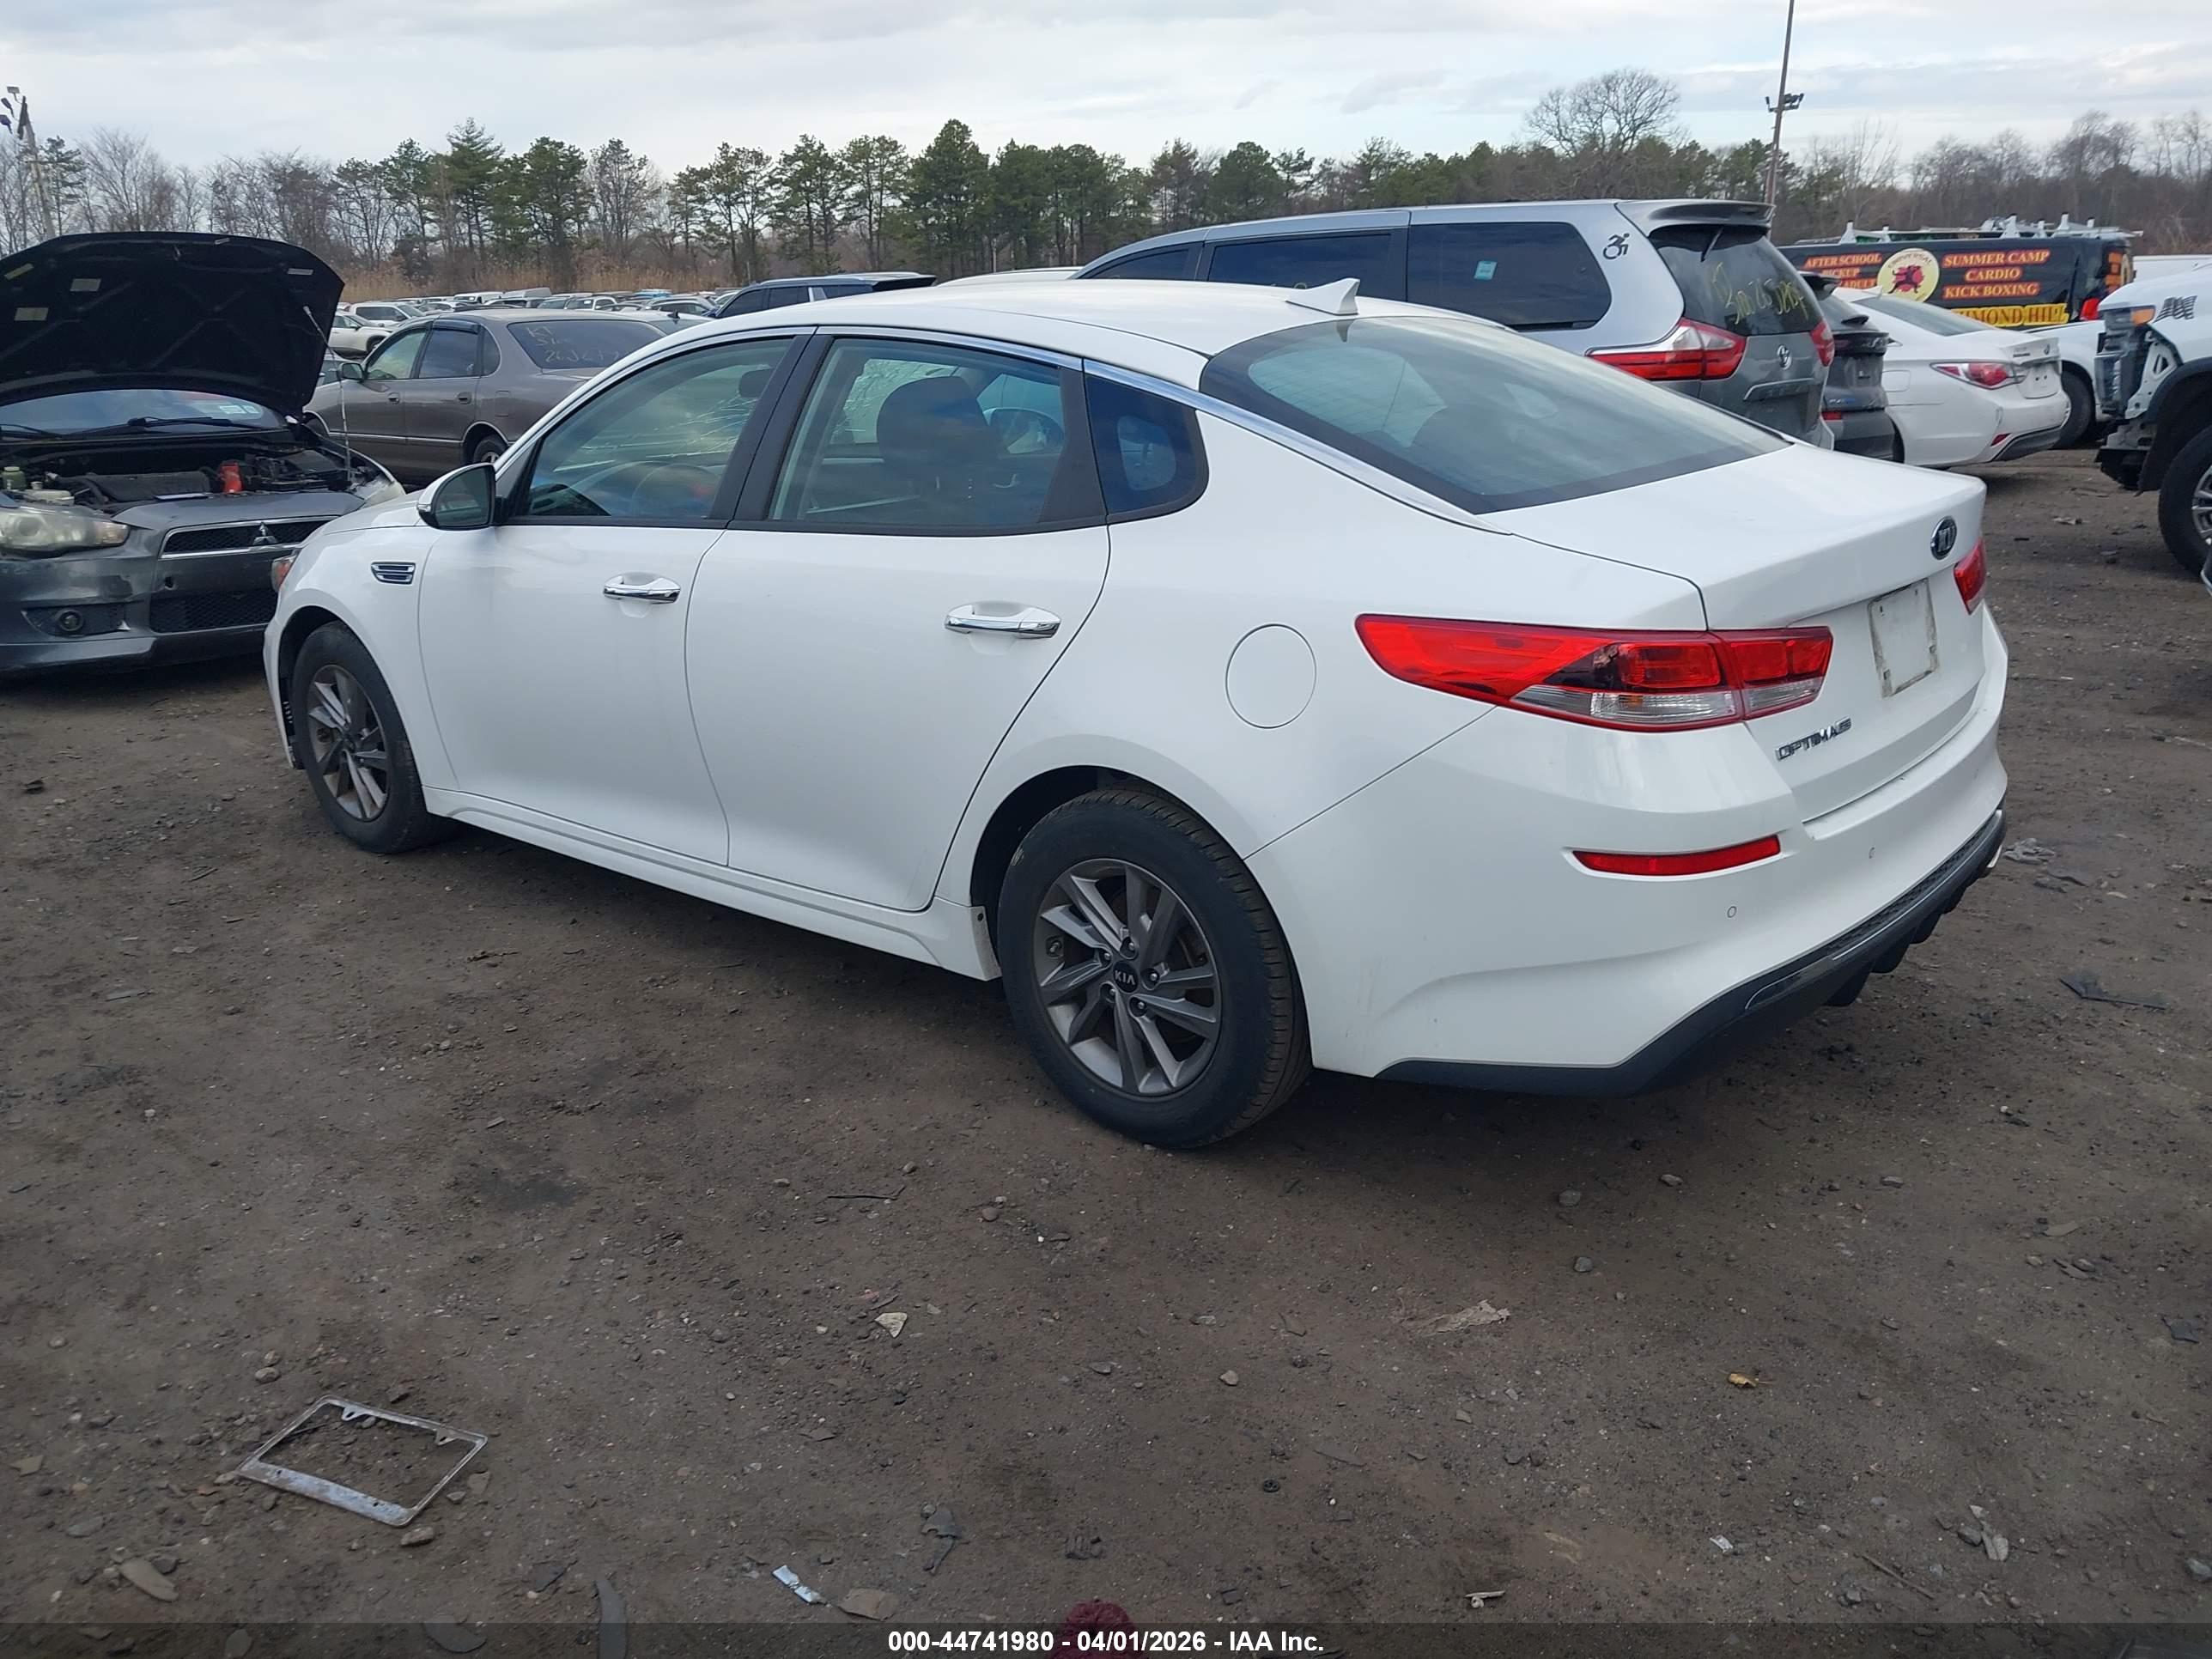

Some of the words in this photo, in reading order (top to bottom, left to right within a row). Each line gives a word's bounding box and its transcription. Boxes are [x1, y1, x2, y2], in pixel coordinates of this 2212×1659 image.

[1804, 256, 1838, 269] AFTER
[1838, 252, 1882, 267] SCHOOL
[1943, 252, 2005, 267] SUMMER
[2007, 249, 2051, 264] CAMP
[1965, 268, 2021, 282] CARDIO
[1944, 285, 1980, 298] KICK
[1984, 283, 2038, 296] BOXING
[2027, 306, 2066, 323] HILL
